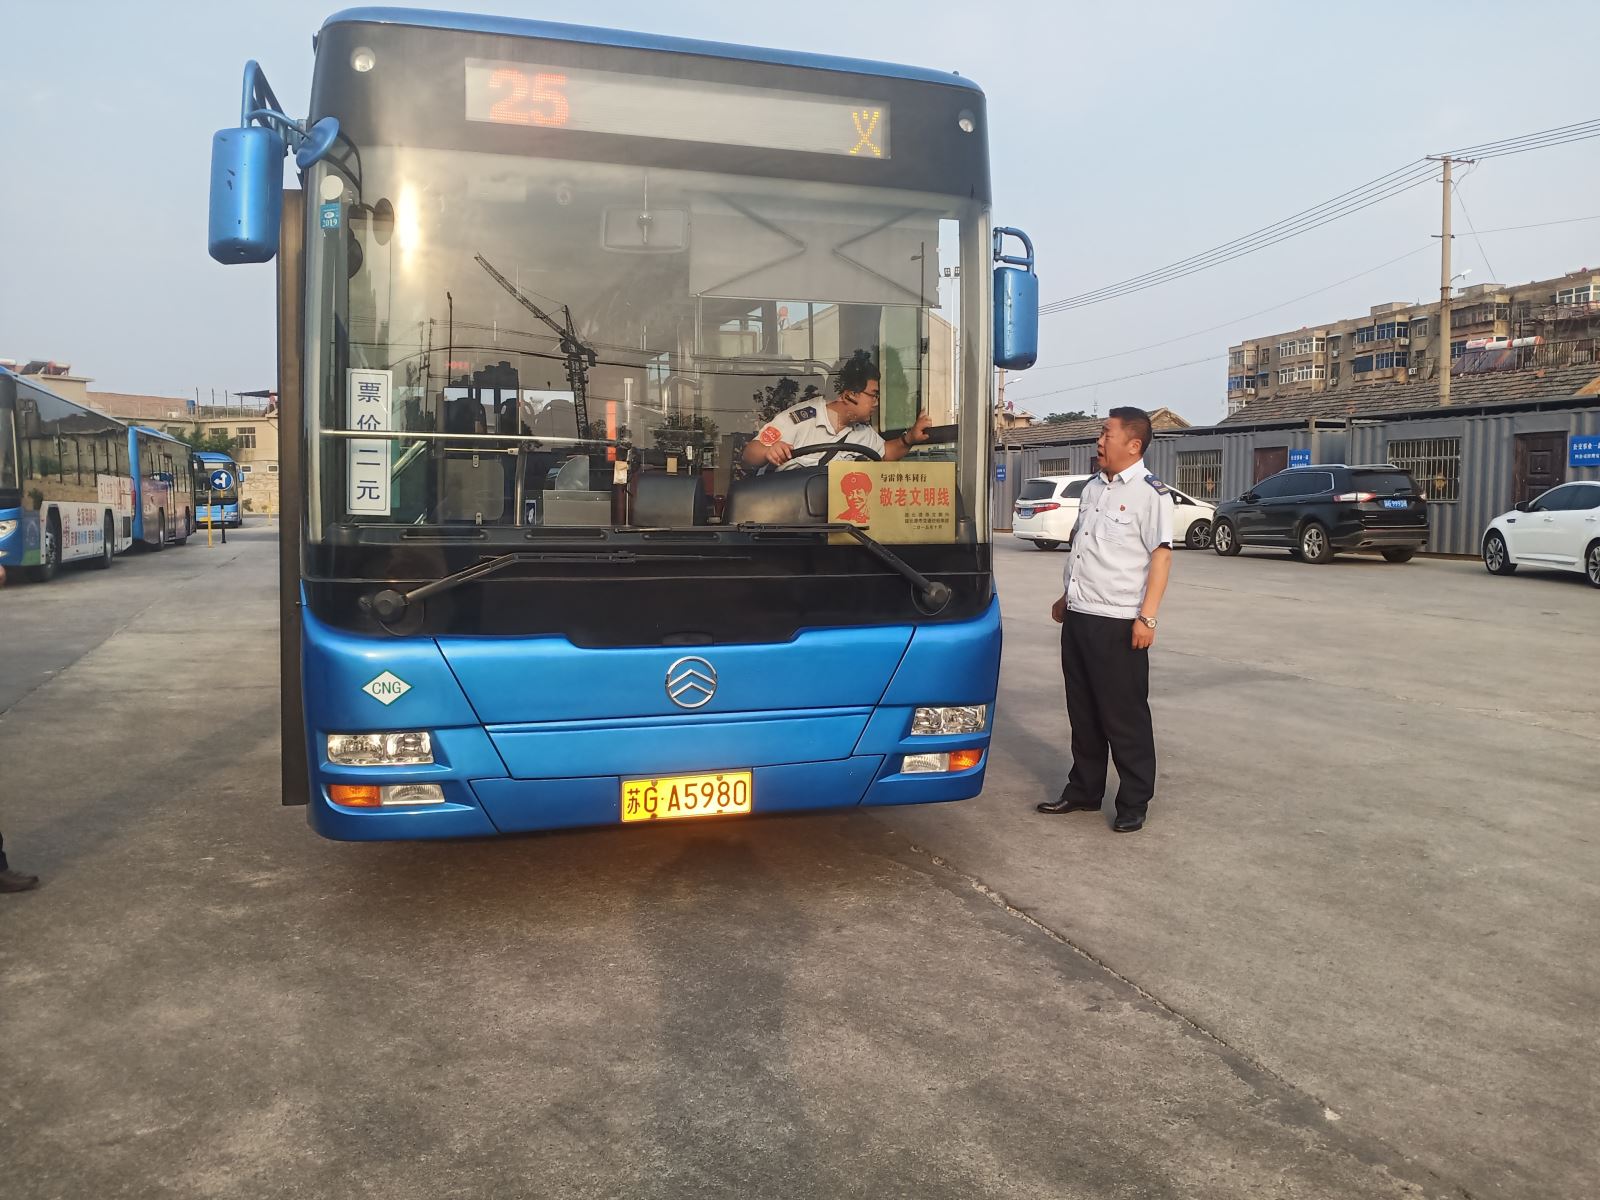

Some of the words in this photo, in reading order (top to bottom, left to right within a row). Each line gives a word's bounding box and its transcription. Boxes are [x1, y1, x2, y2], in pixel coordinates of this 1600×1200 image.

[489, 69, 568, 125] 25
[850, 110, 881, 155] 义
[322, 218, 338, 227] 2019
[357, 382, 381, 500] 票价二元
[880, 487, 949, 506] 敬老文明线
[372, 681, 401, 694] CNG
